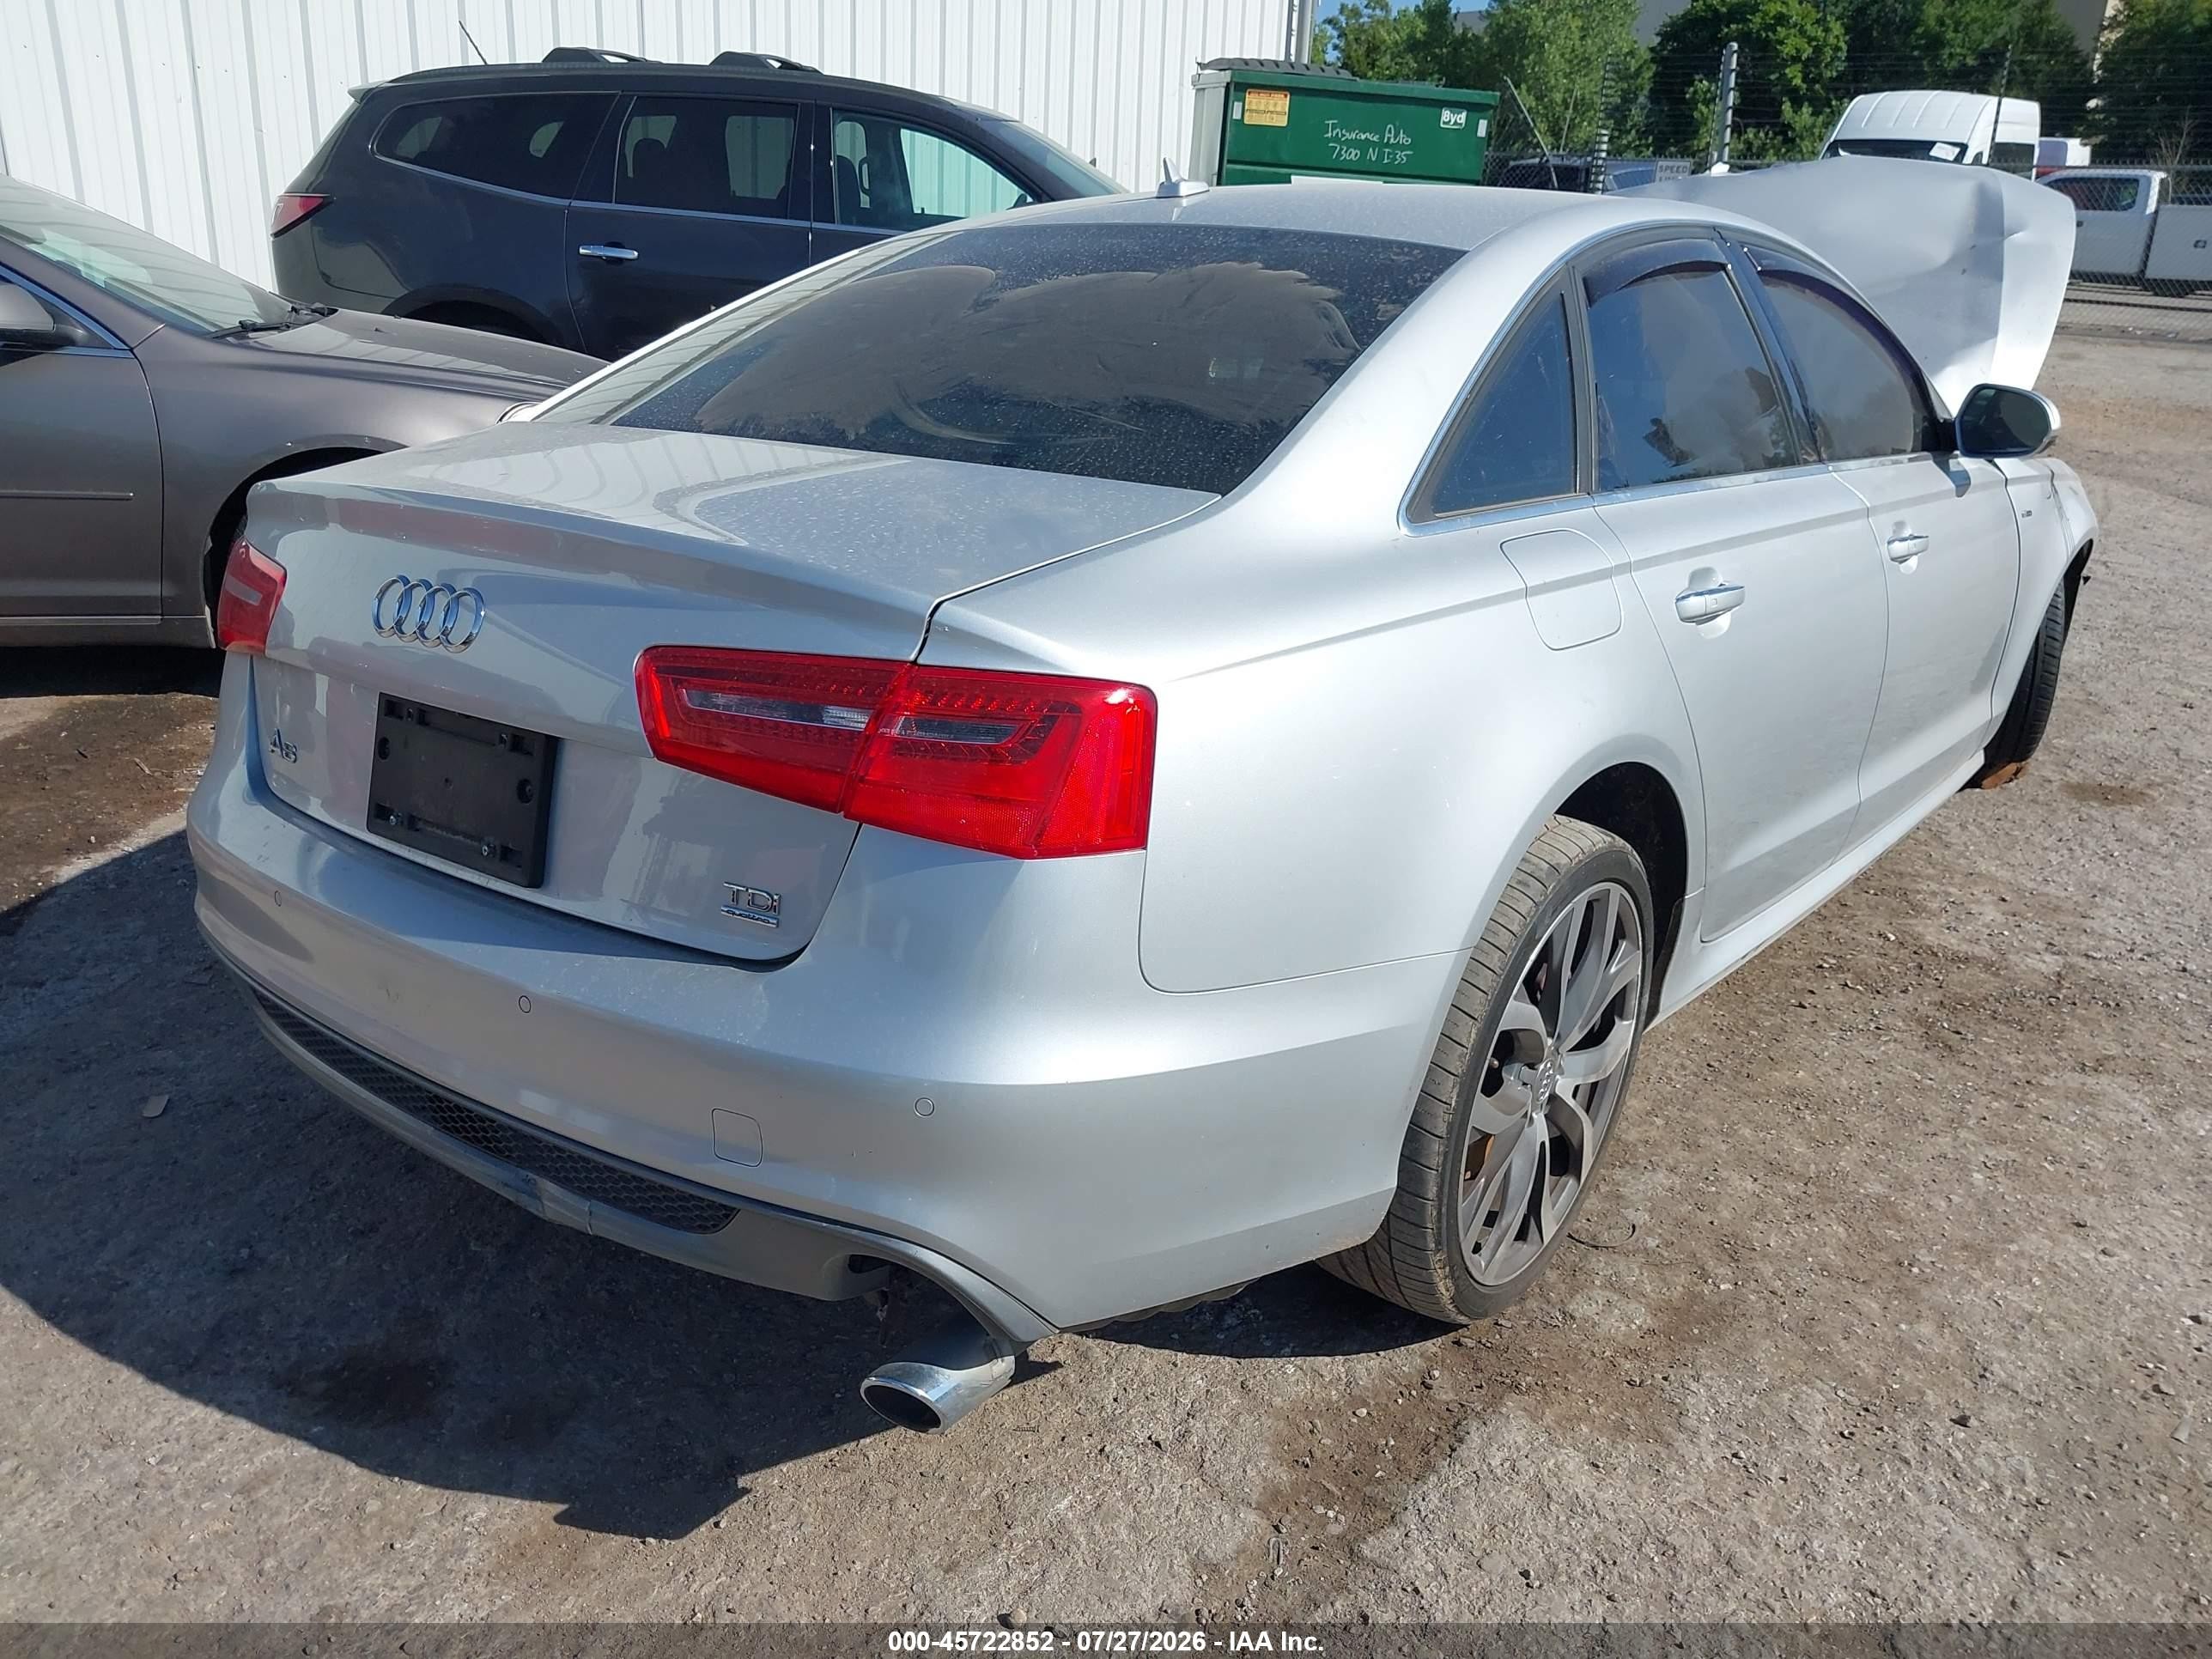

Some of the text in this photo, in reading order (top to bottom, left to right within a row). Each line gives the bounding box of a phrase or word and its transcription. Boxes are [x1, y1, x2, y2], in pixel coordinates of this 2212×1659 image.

[1443, 110, 1465, 125] 8yd
[1323, 119, 1412, 145] Insurance Auto
[1328, 143, 1361, 161] 7300
[1366, 147, 1378, 161] N
[268, 727, 297, 764] A6
[726, 908, 771, 925] quattro
